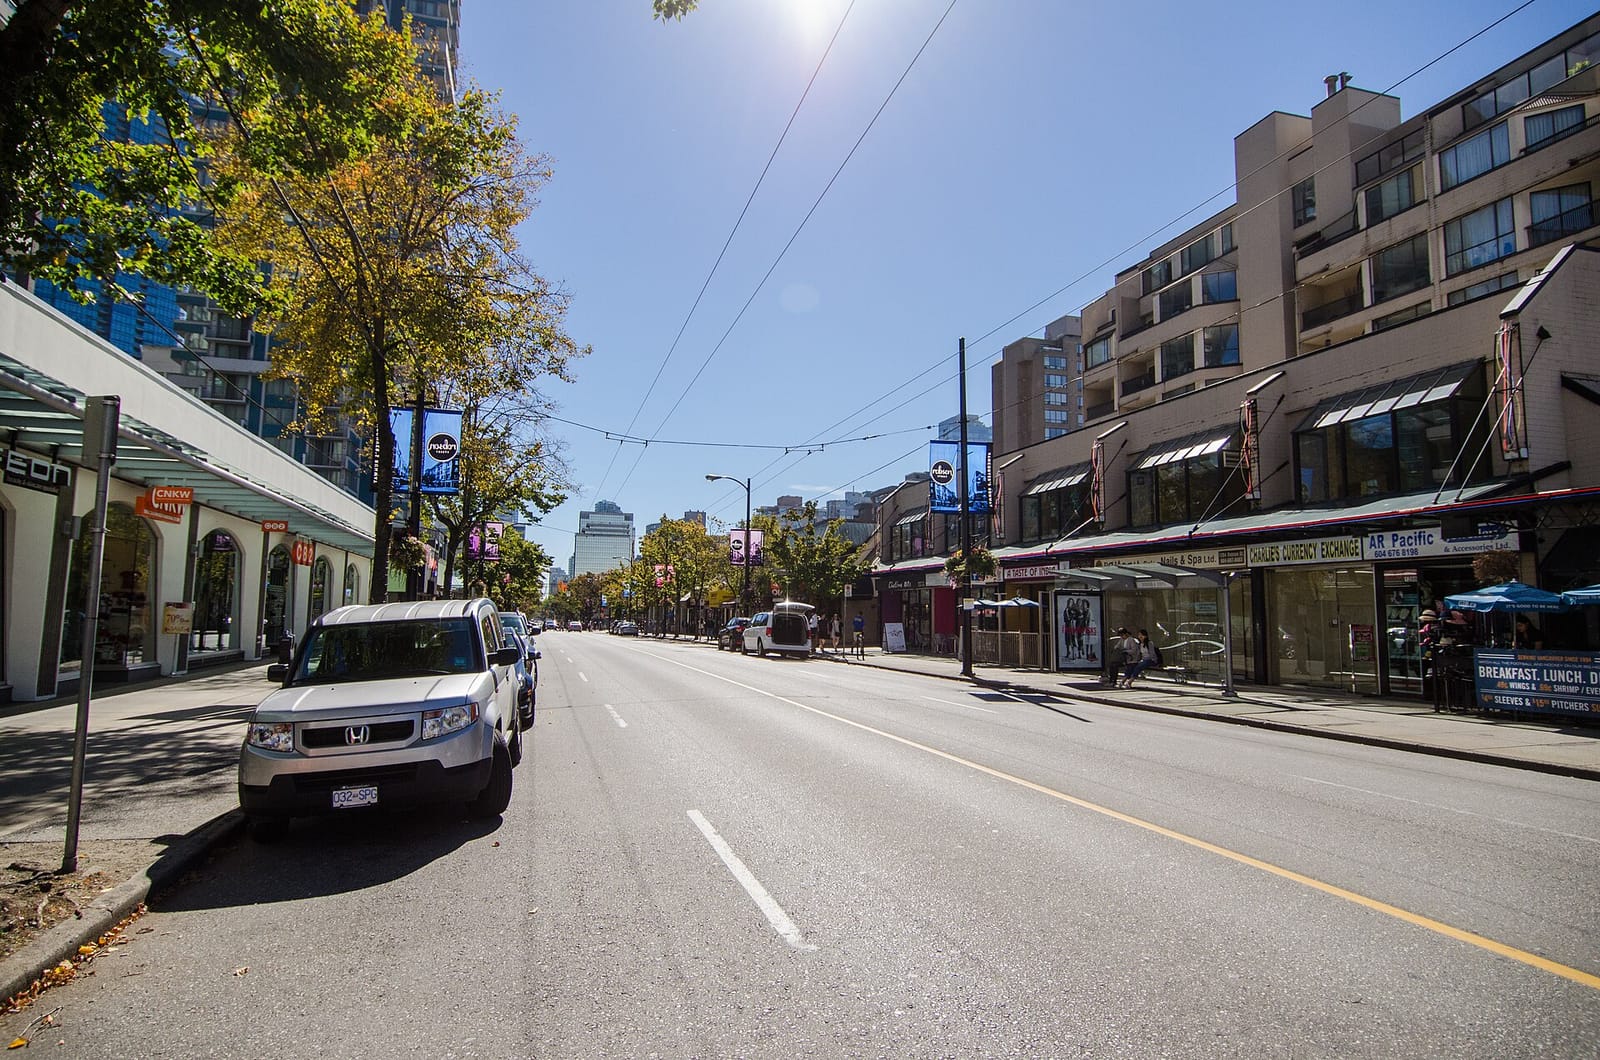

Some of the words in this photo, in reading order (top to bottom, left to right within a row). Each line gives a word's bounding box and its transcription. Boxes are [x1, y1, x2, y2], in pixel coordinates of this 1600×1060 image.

[931, 464, 953, 476] robson
[156, 489, 191, 498] CNKW
[1369, 534, 1385, 549] AR
[1391, 531, 1434, 548] Pacific
[296, 543, 314, 563] CB2
[1249, 545, 1280, 563] CHARLIE'S
[1282, 542, 1318, 561] CURRENCY
[1321, 539, 1360, 558] EXCHANGE
[1374, 549, 1387, 558] 604
[1388, 548, 1401, 557] 676
[1451, 543, 1494, 553] Accessories
[1495, 542, 1511, 550] Ltd.
[1160, 556, 1179, 566] Nails
[1180, 555, 1186, 564] &
[1187, 554, 1202, 566] Spa
[1203, 555, 1217, 563] Ltd.
[1006, 568, 1011, 577] A
[1012, 568, 1028, 577] TASTE
[1030, 567, 1038, 576] OF
[1479, 666, 1540, 681] BREAKFAST.
[1543, 669, 1586, 684] LUNCH.
[1509, 682, 1530, 691] WINGS
[1531, 683, 1537, 691] &
[1553, 685, 1579, 694] SHRIMP
[1494, 695, 1523, 706] SLEEVES
[1524, 697, 1531, 707] &
[1551, 700, 1590, 712] PITCHERS
[359, 789, 377, 801] SPG
